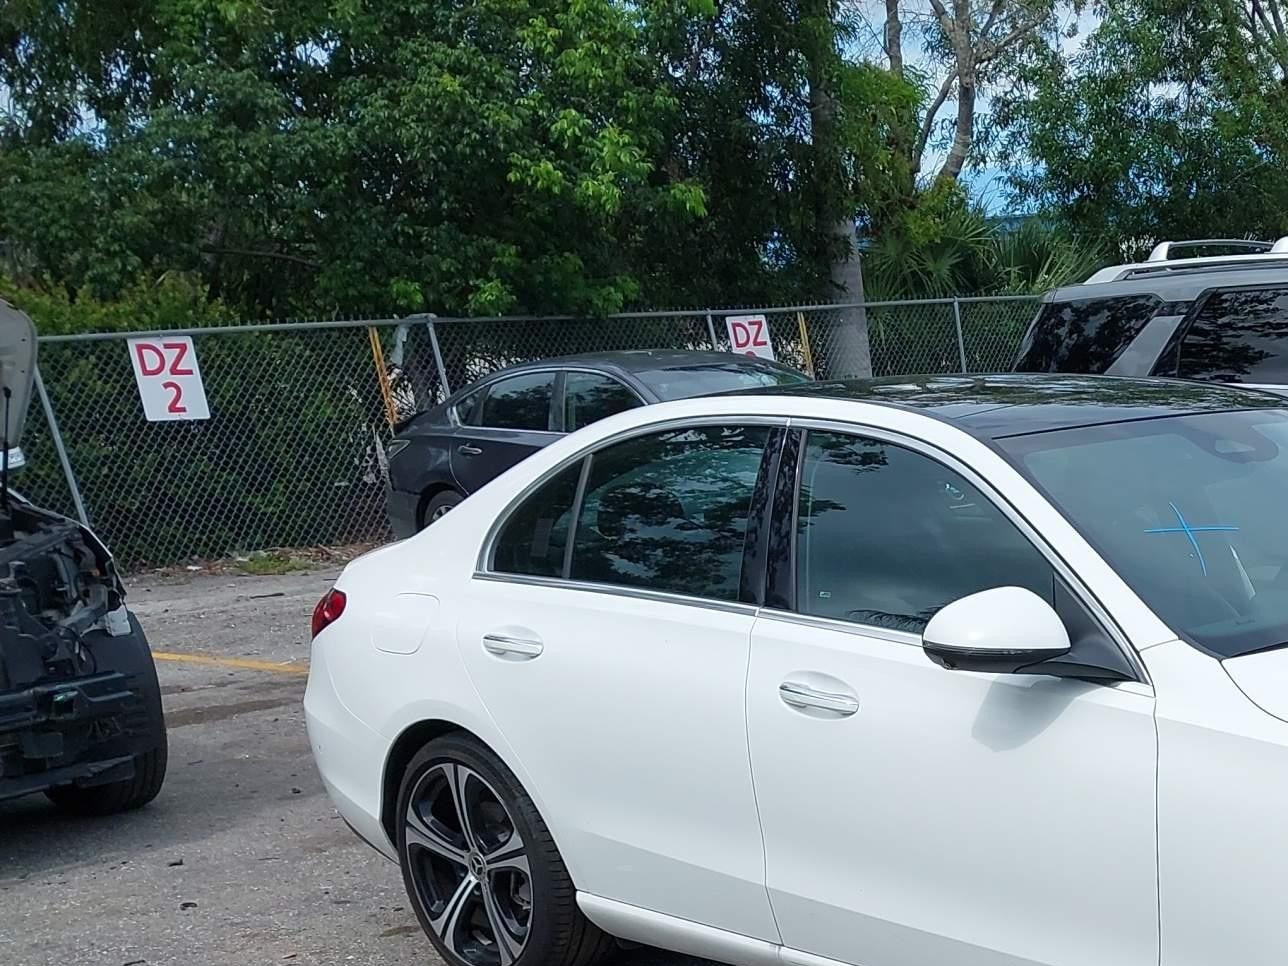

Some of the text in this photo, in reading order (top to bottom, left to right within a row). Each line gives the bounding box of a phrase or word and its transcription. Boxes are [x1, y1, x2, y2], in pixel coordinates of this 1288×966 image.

[731, 320, 767, 348] DZ
[135, 343, 194, 376] DZ
[162, 381, 187, 413] 2
